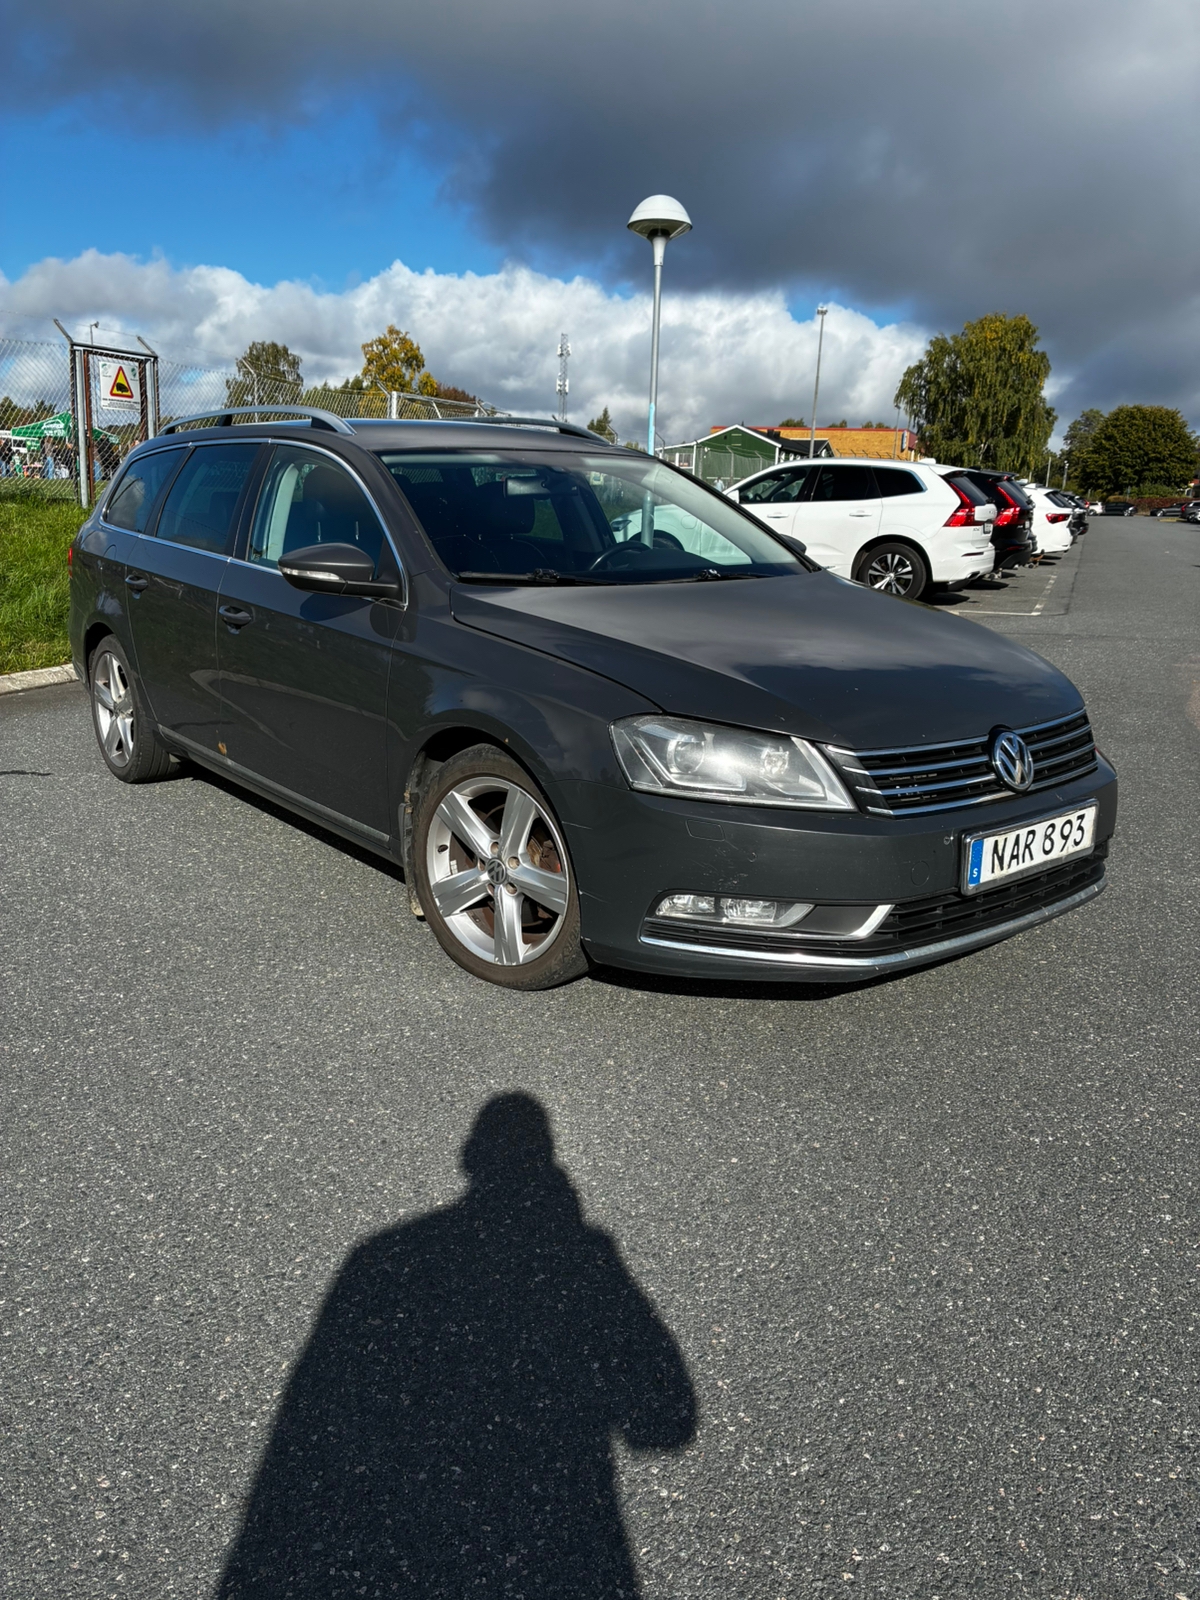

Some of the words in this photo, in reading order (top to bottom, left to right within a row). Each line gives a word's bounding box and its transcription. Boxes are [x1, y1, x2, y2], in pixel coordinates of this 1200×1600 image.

[991, 829, 1036, 874] NAR
[1042, 813, 1086, 856] 893
[972, 867, 979, 878] S
